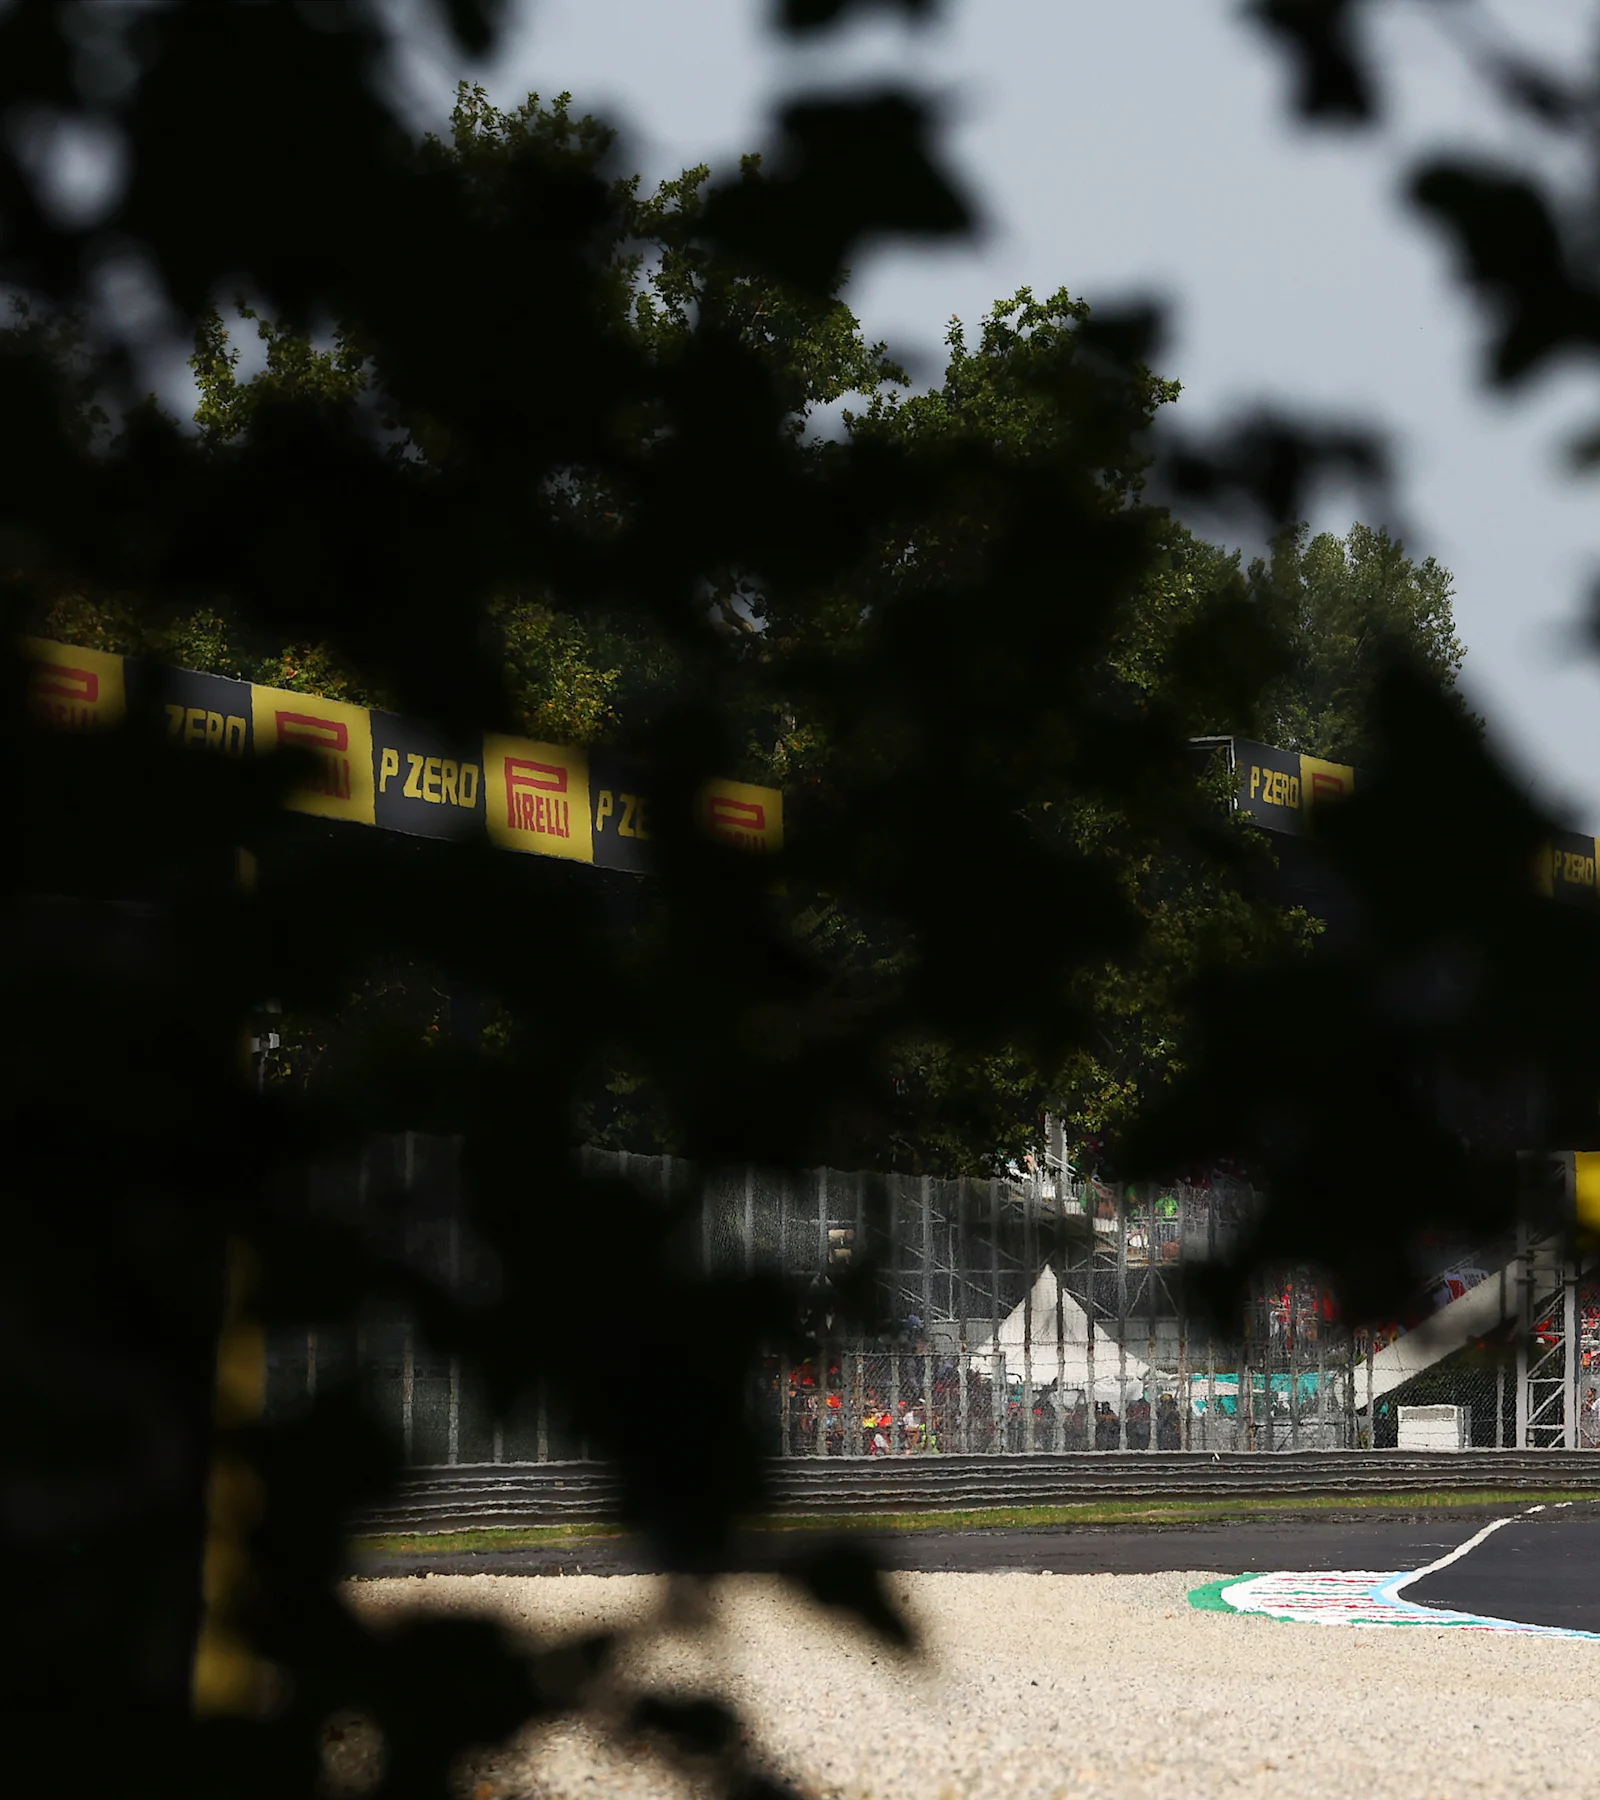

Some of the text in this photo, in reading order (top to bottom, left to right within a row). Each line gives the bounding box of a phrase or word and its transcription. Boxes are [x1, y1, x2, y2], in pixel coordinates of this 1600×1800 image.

[380, 747, 479, 809] P ZERO
[504, 756, 570, 838] PIRELLI
[1250, 765, 1260, 799] P
[1262, 768, 1300, 810] ZERO
[596, 789, 613, 832] P
